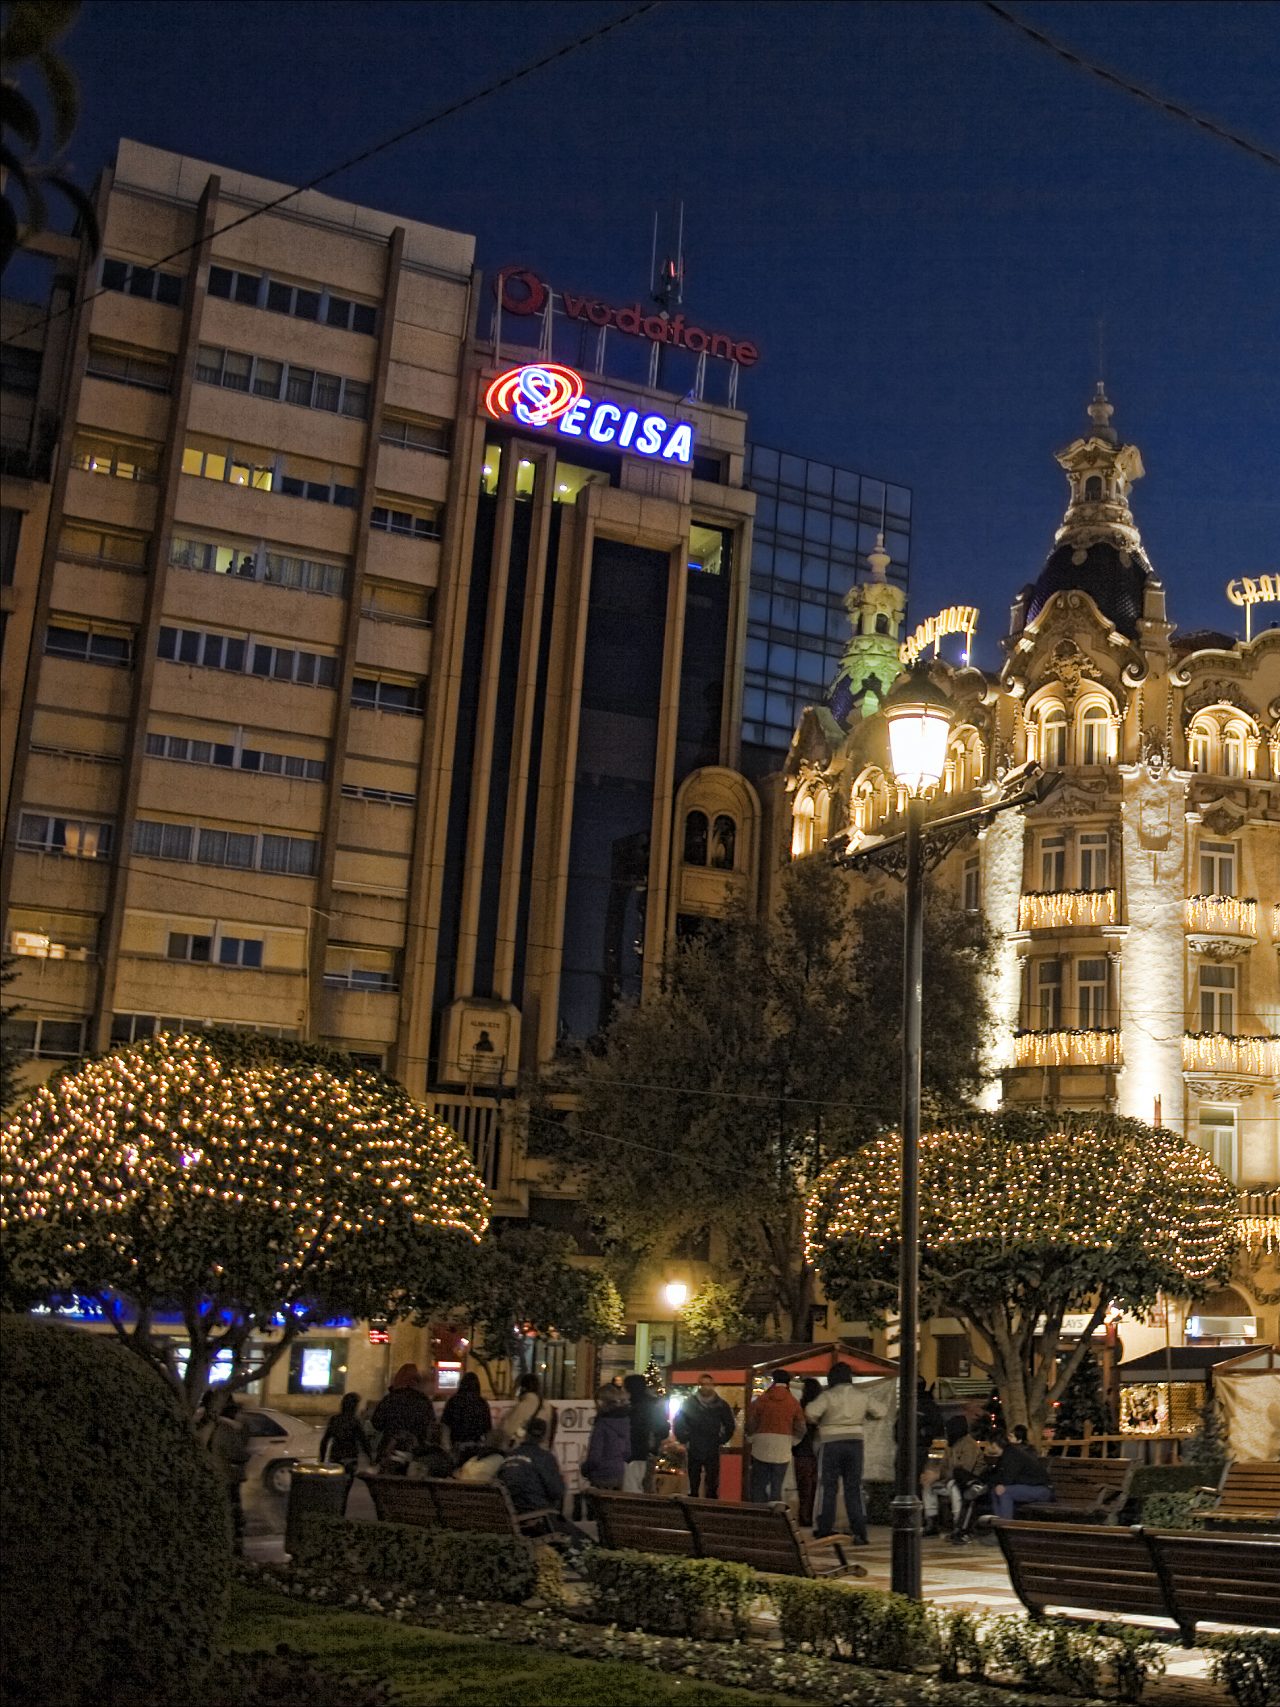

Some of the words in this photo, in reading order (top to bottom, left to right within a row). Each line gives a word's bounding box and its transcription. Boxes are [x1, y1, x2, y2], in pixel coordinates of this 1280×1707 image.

[563, 291, 760, 366] vodafone
[899, 617, 935, 664] GRAN
[935, 606, 979, 636] HOTEL
